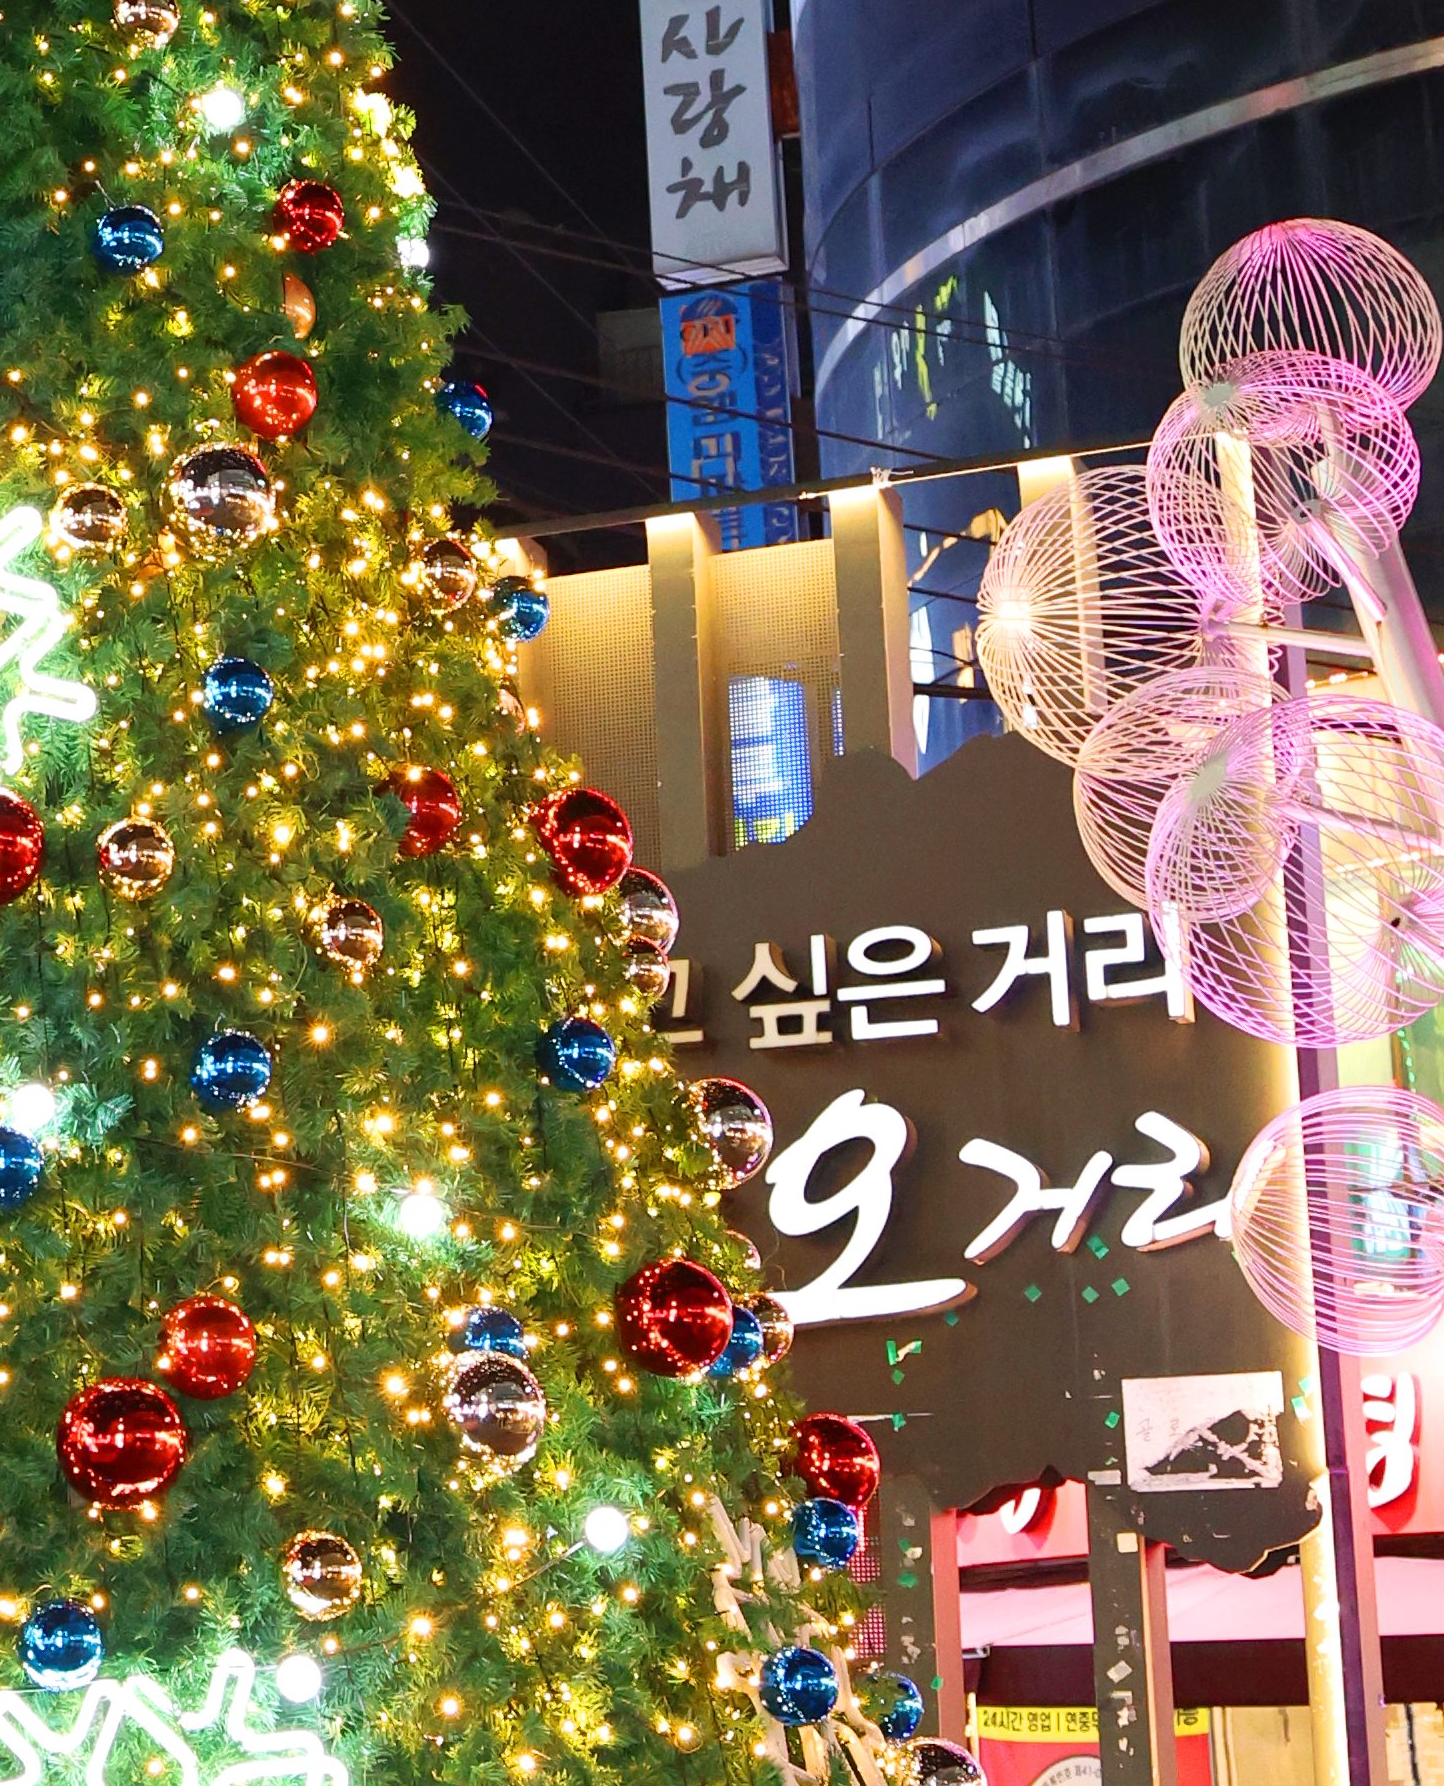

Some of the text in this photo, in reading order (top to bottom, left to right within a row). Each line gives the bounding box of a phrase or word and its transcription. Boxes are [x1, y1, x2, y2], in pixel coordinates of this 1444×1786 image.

[661, 5, 751, 219] 사랑채
[731, 925, 946, 1049] 싶은
[971, 901, 1188, 1026] 거리
[1027, 1711, 1052, 1733] 영업
